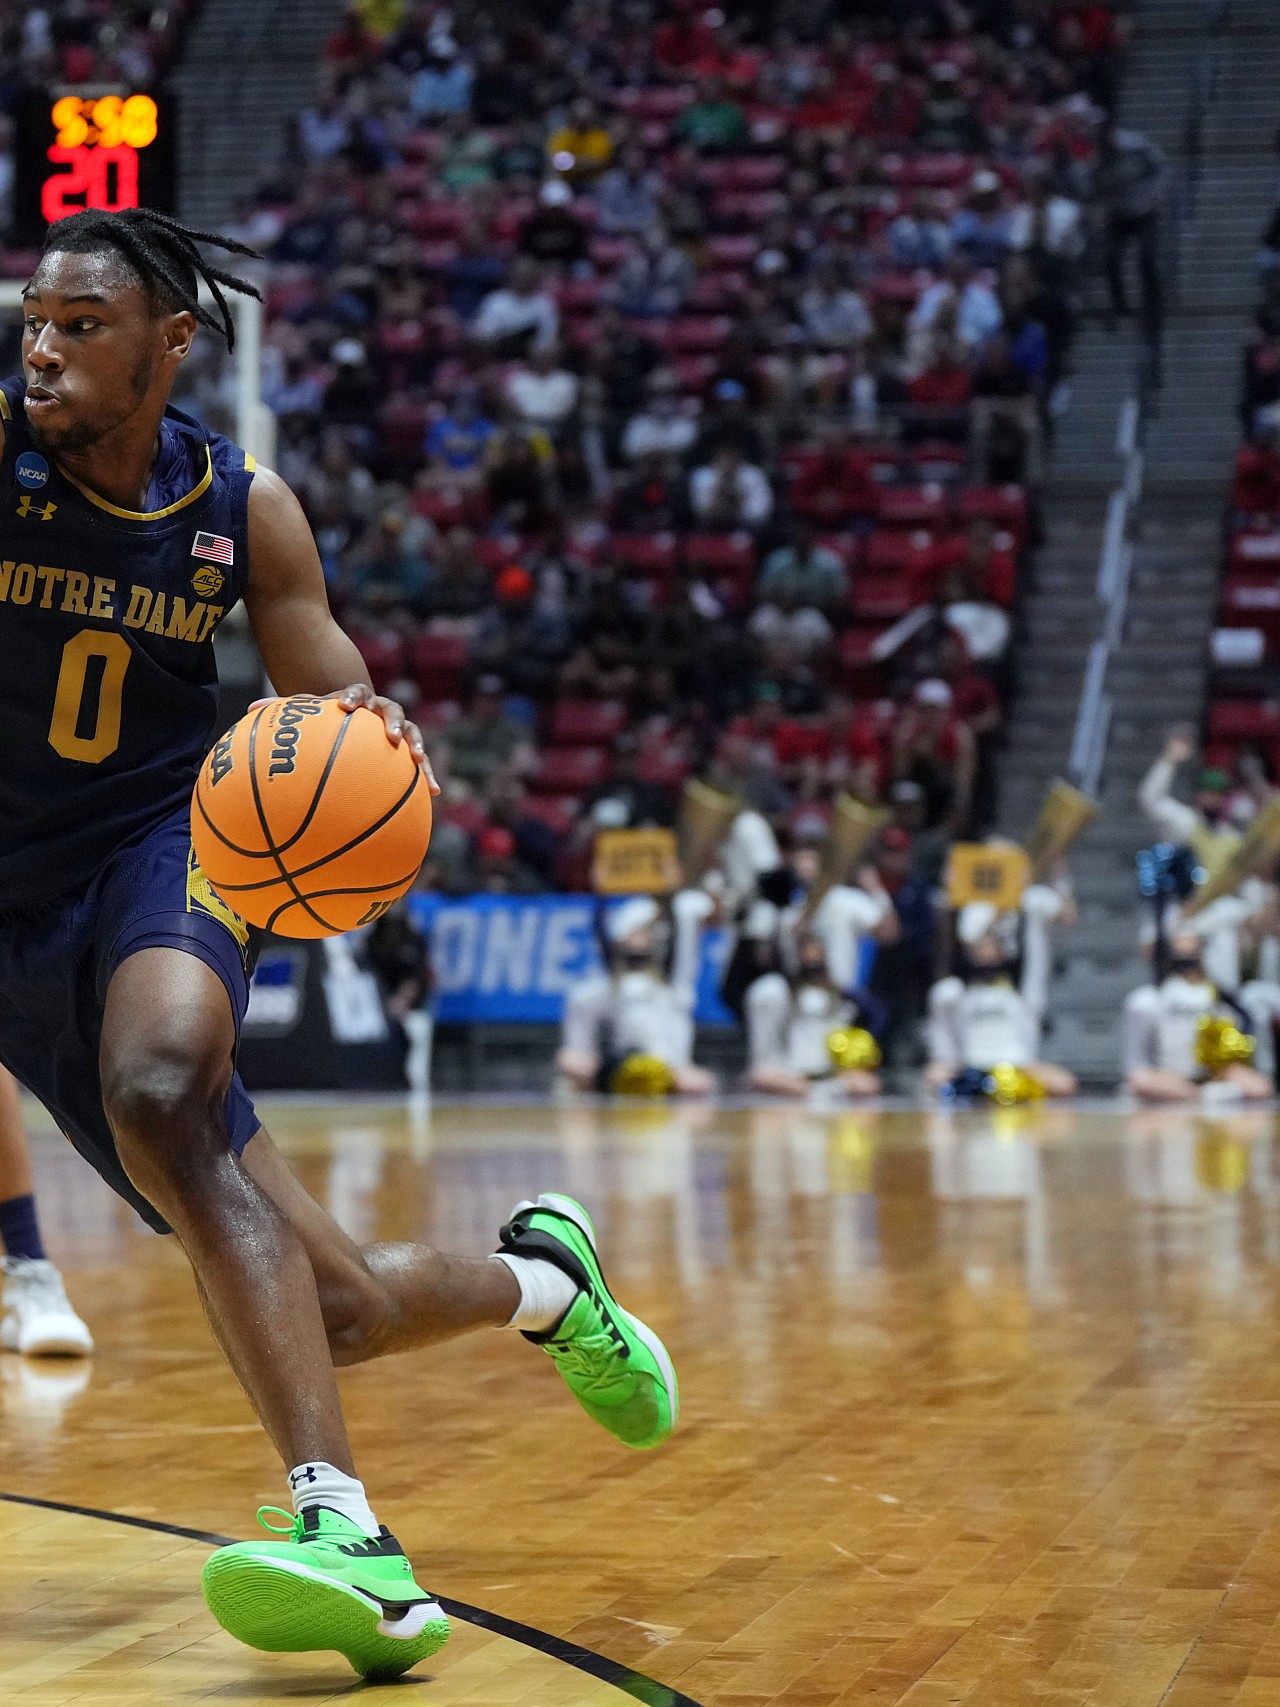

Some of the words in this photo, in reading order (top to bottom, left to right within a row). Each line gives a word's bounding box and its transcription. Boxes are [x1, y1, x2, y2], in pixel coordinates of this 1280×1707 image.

[41, 143, 139, 224] 20
[18, 466, 47, 482] NCAA
[48, 628, 132, 764] 0
[268, 697, 323, 777] ilson
